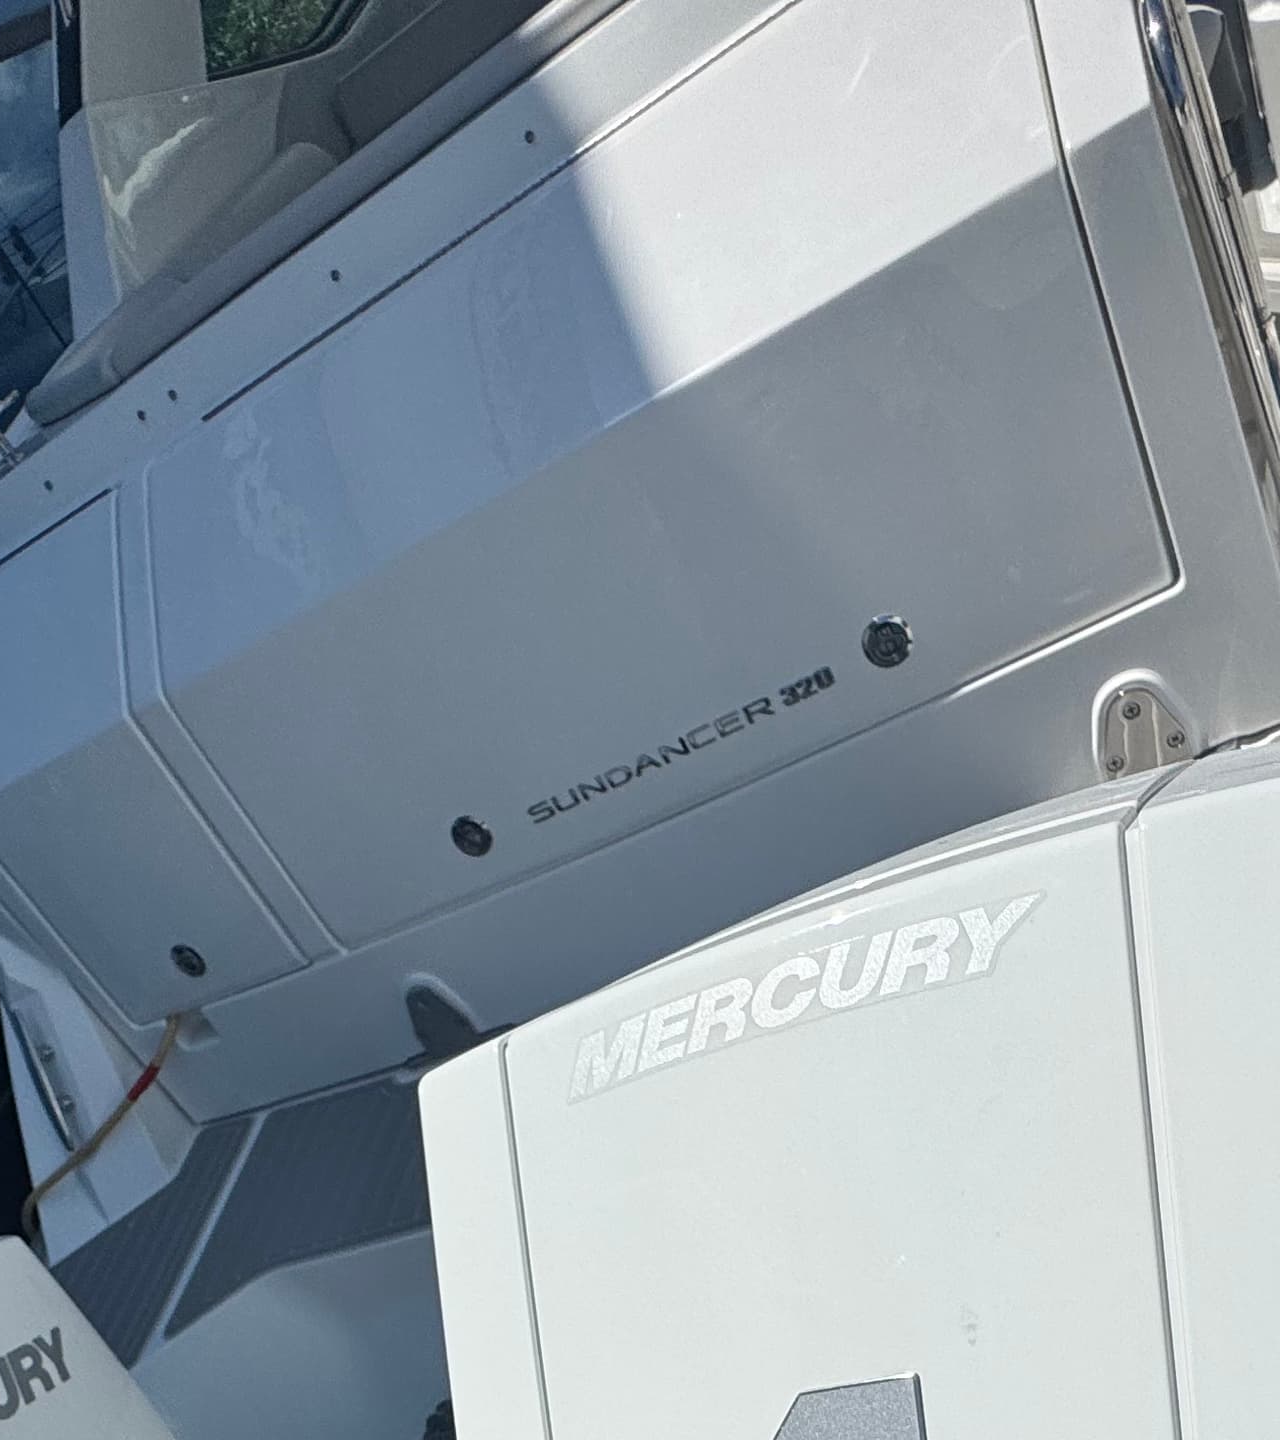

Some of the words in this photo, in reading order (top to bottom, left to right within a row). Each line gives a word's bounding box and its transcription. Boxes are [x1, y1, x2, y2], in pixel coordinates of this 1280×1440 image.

[526, 695, 775, 824] SUNDANCER
[778, 665, 837, 707] 320
[569, 889, 1046, 1104] MERCURY
